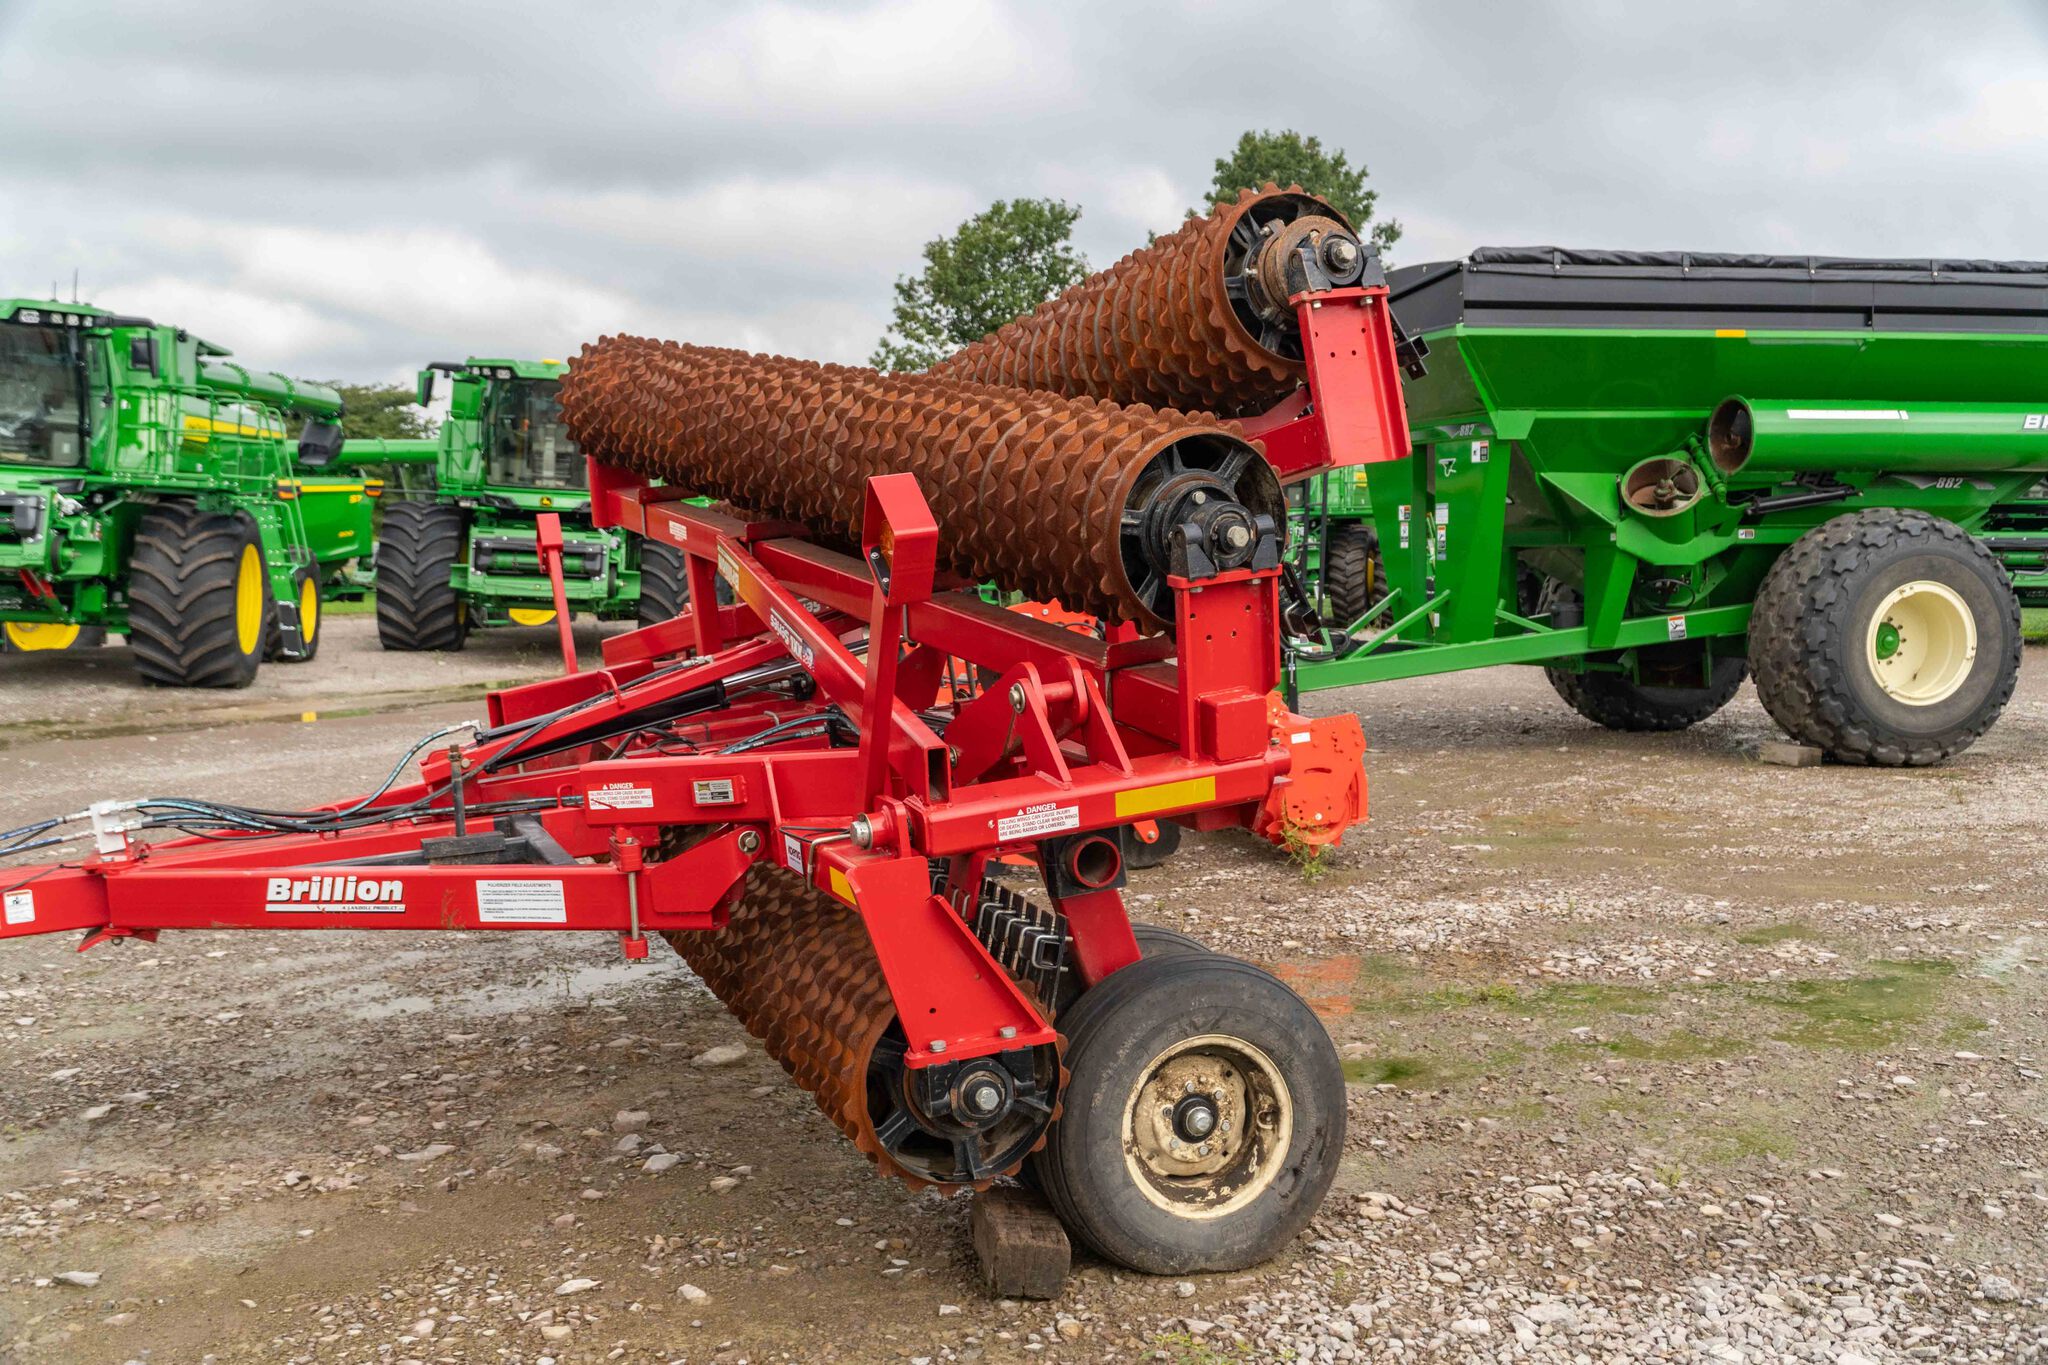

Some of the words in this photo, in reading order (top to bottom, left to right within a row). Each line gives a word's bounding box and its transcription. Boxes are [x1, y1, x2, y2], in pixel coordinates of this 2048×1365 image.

[1459, 424, 1475, 436] 882
[1936, 477, 1964, 489] 882
[609, 782, 634, 790] DANGER
[1026, 803, 1057, 814] DANGER
[266, 876, 403, 901] Brillion
